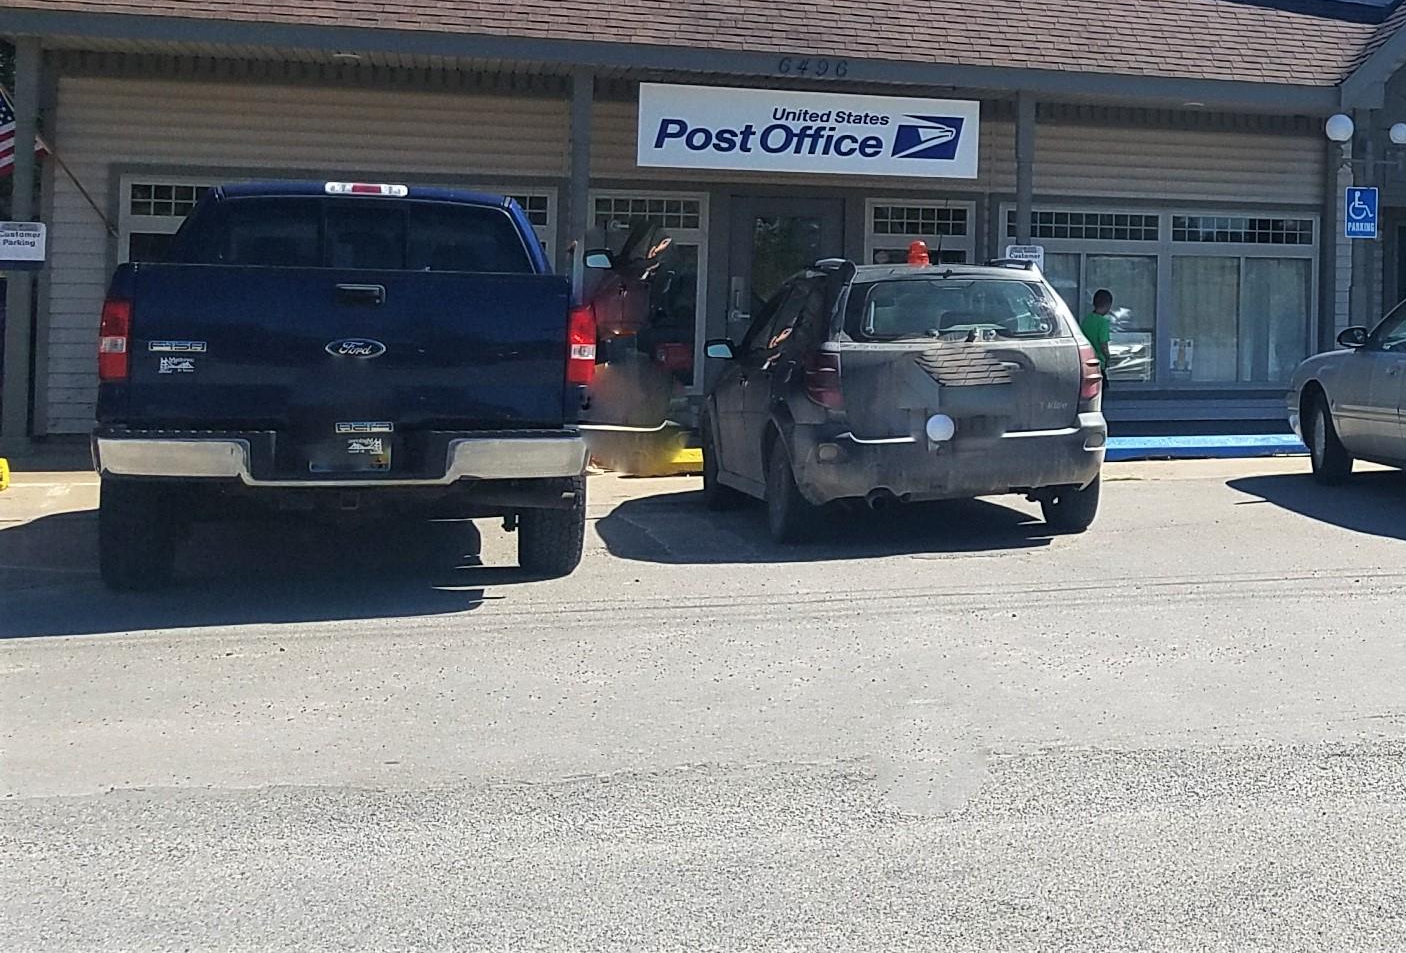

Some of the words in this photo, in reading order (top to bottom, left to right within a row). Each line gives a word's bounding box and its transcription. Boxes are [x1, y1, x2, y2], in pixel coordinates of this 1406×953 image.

[778, 57, 849, 78] 6496
[772, 107, 831, 124] United
[834, 110, 890, 126] States
[653, 118, 756, 154] Post
[759, 123, 883, 158] Office
[1347, 222, 1375, 232] PARKING
[338, 342, 372, 355] Ford
